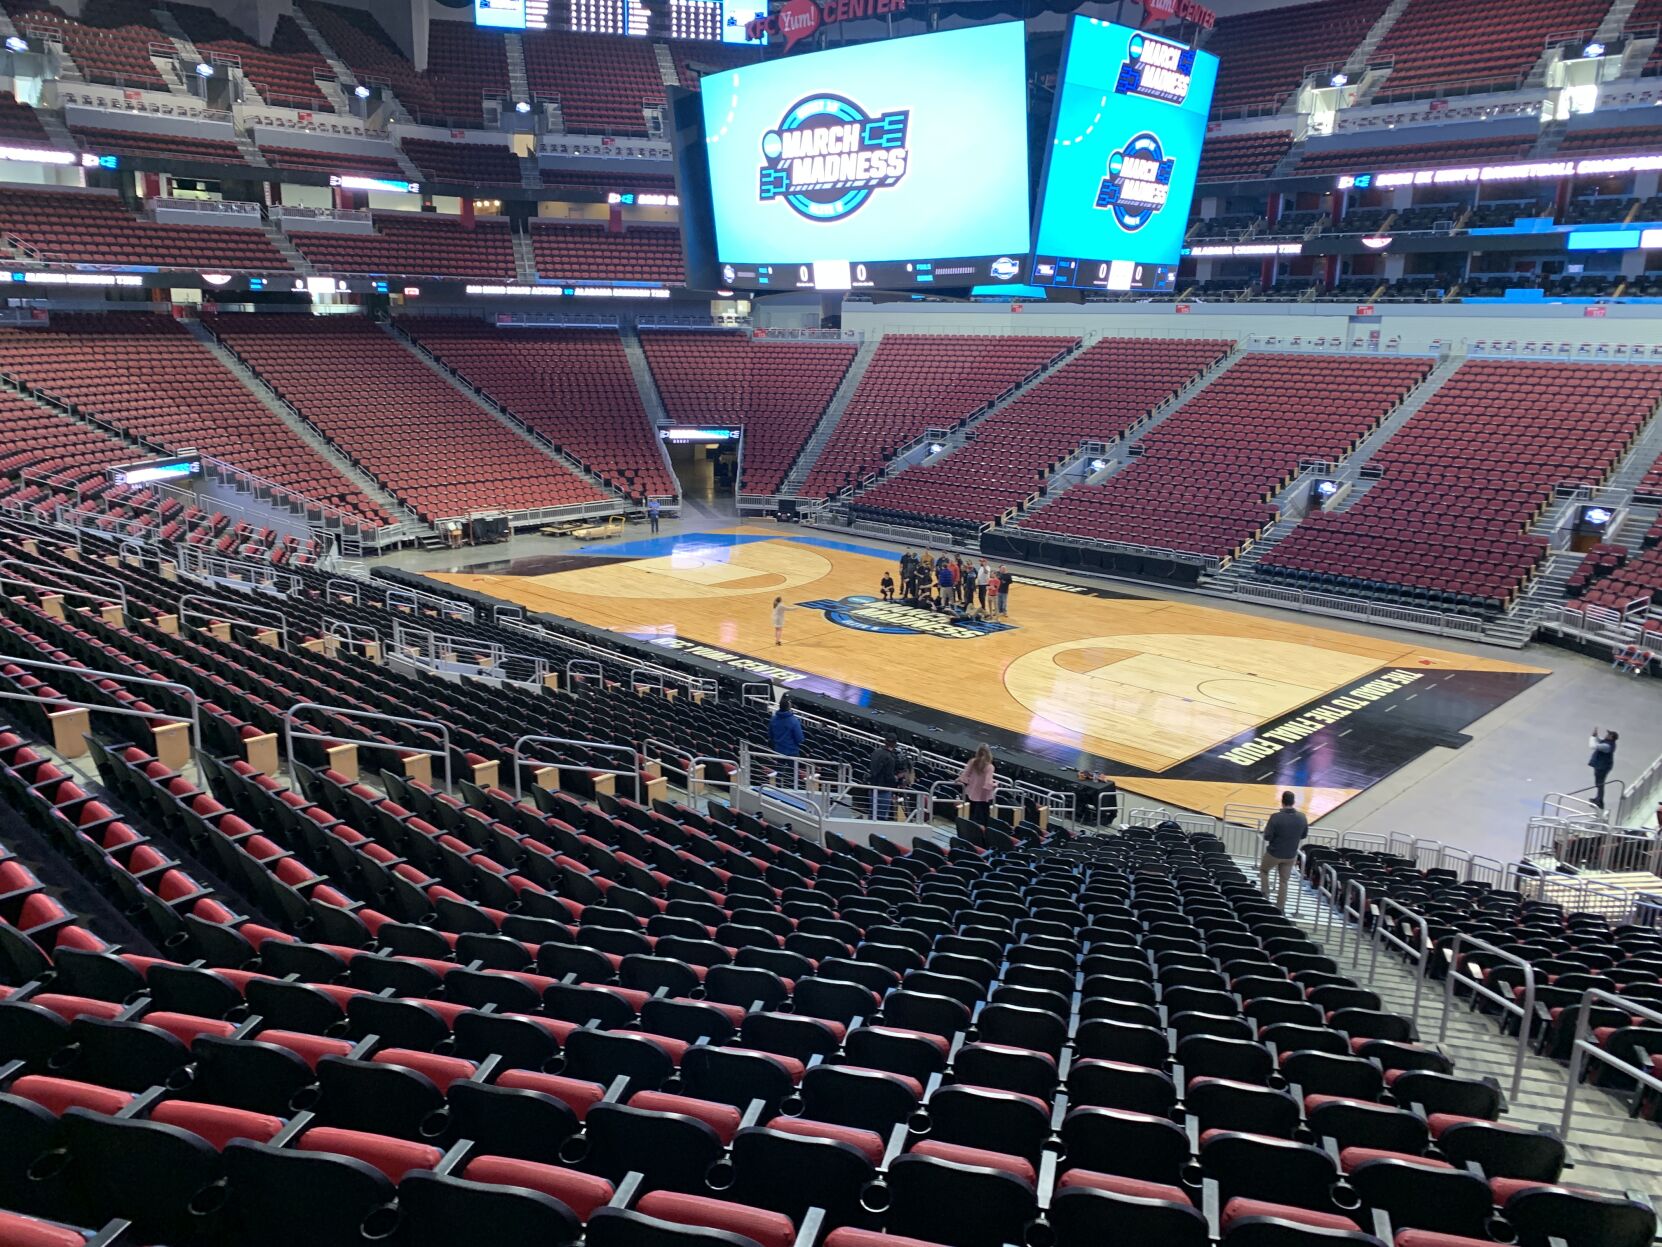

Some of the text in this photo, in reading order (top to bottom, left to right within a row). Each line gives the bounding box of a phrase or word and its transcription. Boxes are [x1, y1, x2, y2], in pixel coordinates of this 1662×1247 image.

[781, 6, 816, 32] Yum!
[1177, 1, 1216, 30] CENTER
[1140, 39, 1181, 70] MARCH
[1140, 64, 1191, 97] MADNESS
[782, 123, 860, 159] MARCH
[792, 148, 906, 185] MADNESS
[1120, 156, 1160, 181] MARCH
[1120, 178, 1168, 204] MADNESS
[800, 265, 809, 282] 0
[857, 264, 866, 281] 0
[850, 608, 985, 638] MADNESS
[727, 659, 807, 682] CENTER
[1217, 669, 1425, 766] THE ROAD TO THE FINAL FOUR
